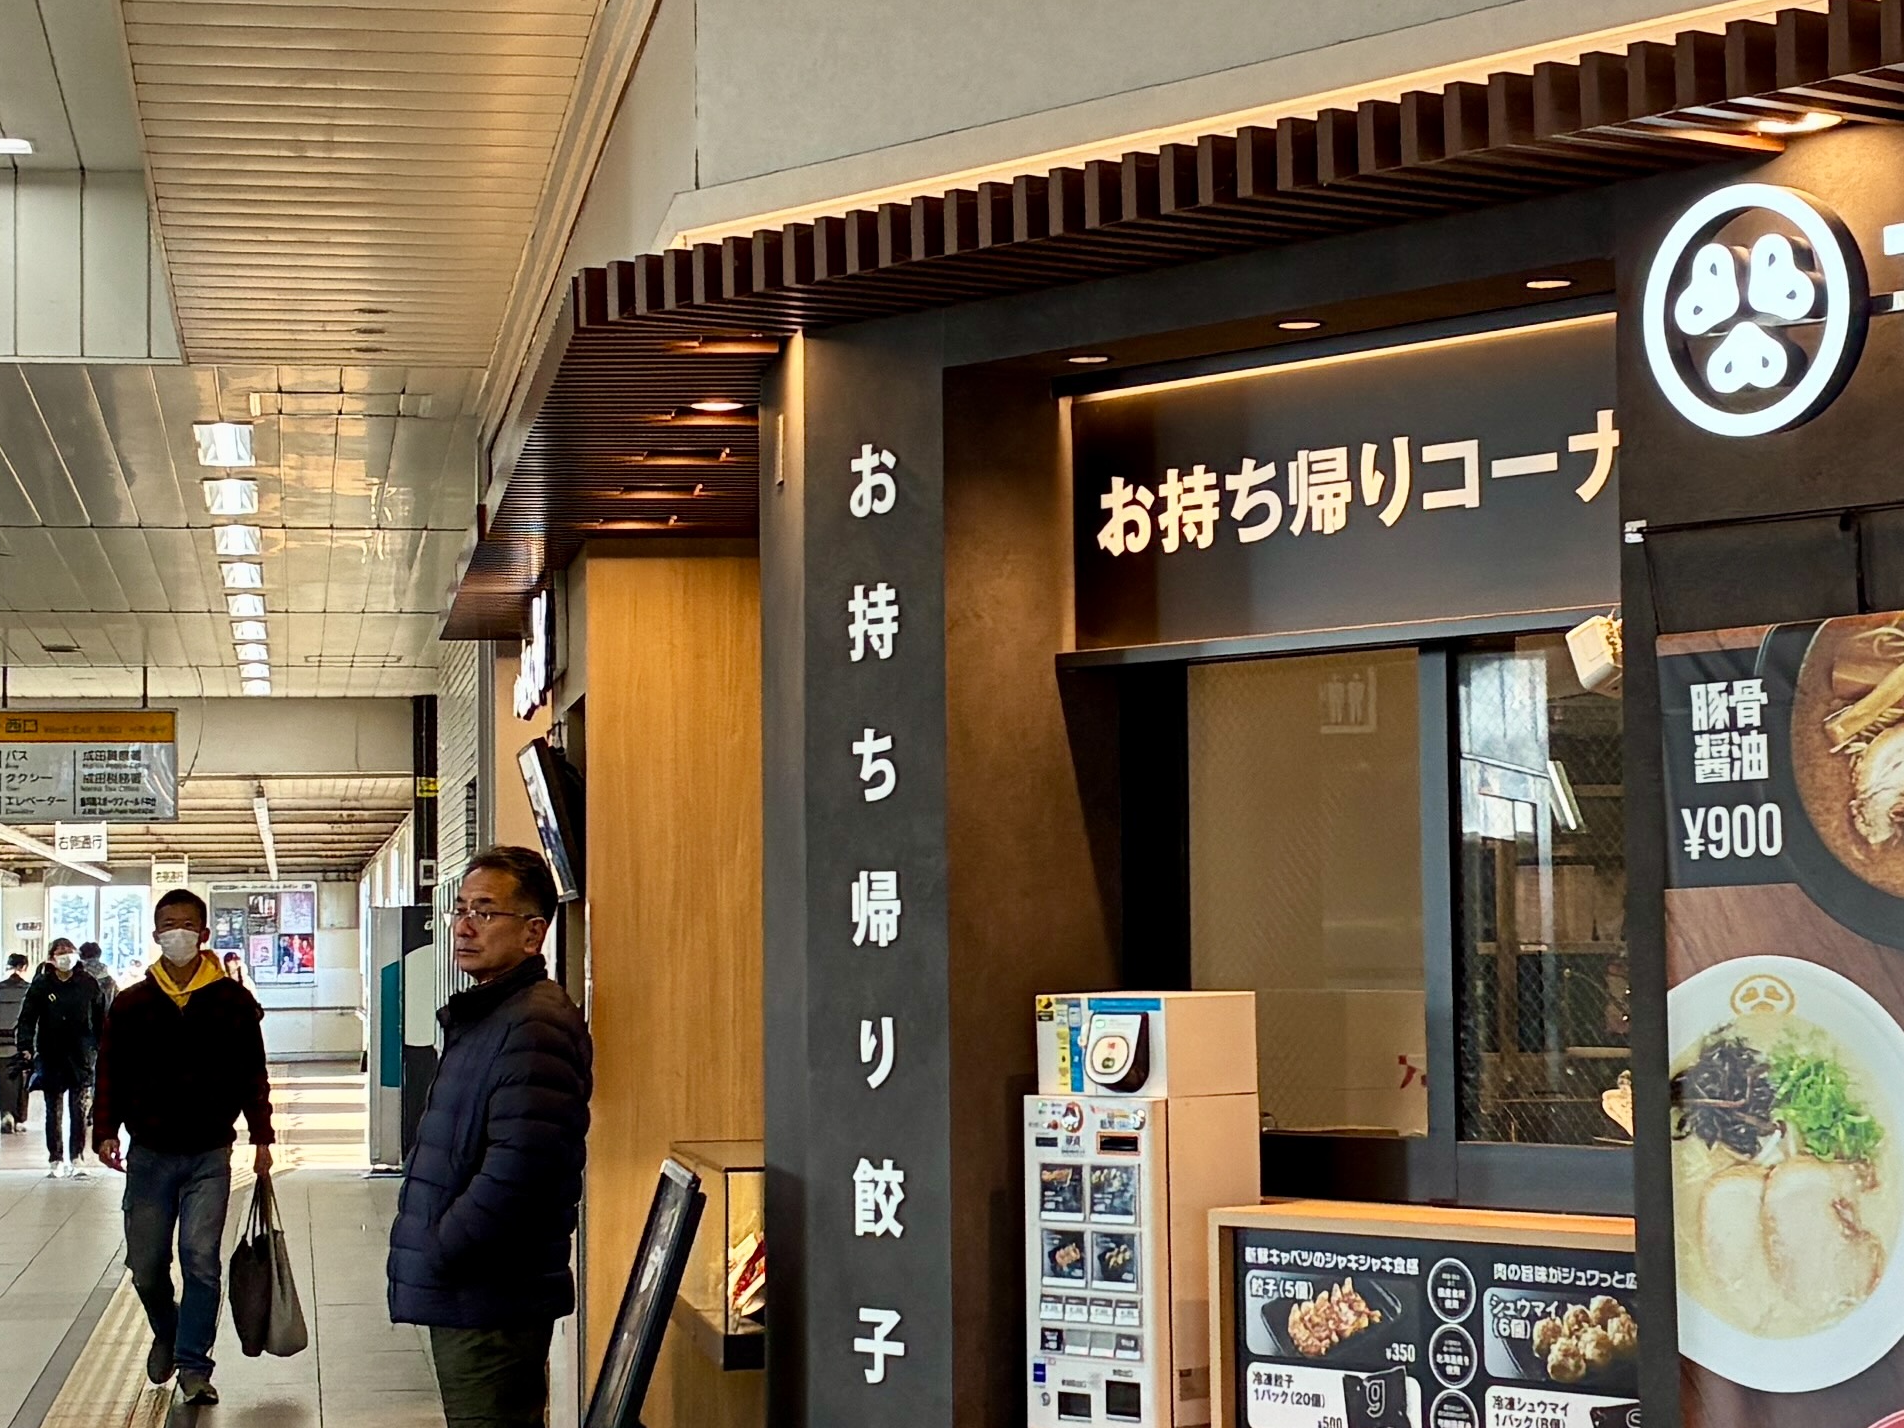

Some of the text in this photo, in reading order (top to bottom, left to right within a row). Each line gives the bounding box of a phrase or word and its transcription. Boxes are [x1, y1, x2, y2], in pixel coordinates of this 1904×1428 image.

[1097, 409, 1620, 557] お持ち帰りコーナ
[1690, 679, 1769, 731] 豚骨
[5, 750, 29, 762] バス
[1693, 731, 1769, 784] 醤油
[1681, 803, 1783, 860] ¥900
[847, 443, 905, 1385] お持ち帰り餃子
[1490, 1294, 1558, 1318] シュウマイ
[1385, 1343, 1416, 1363] ¥350
[1492, 1395, 1569, 1417] 冷凍シュウマイ
